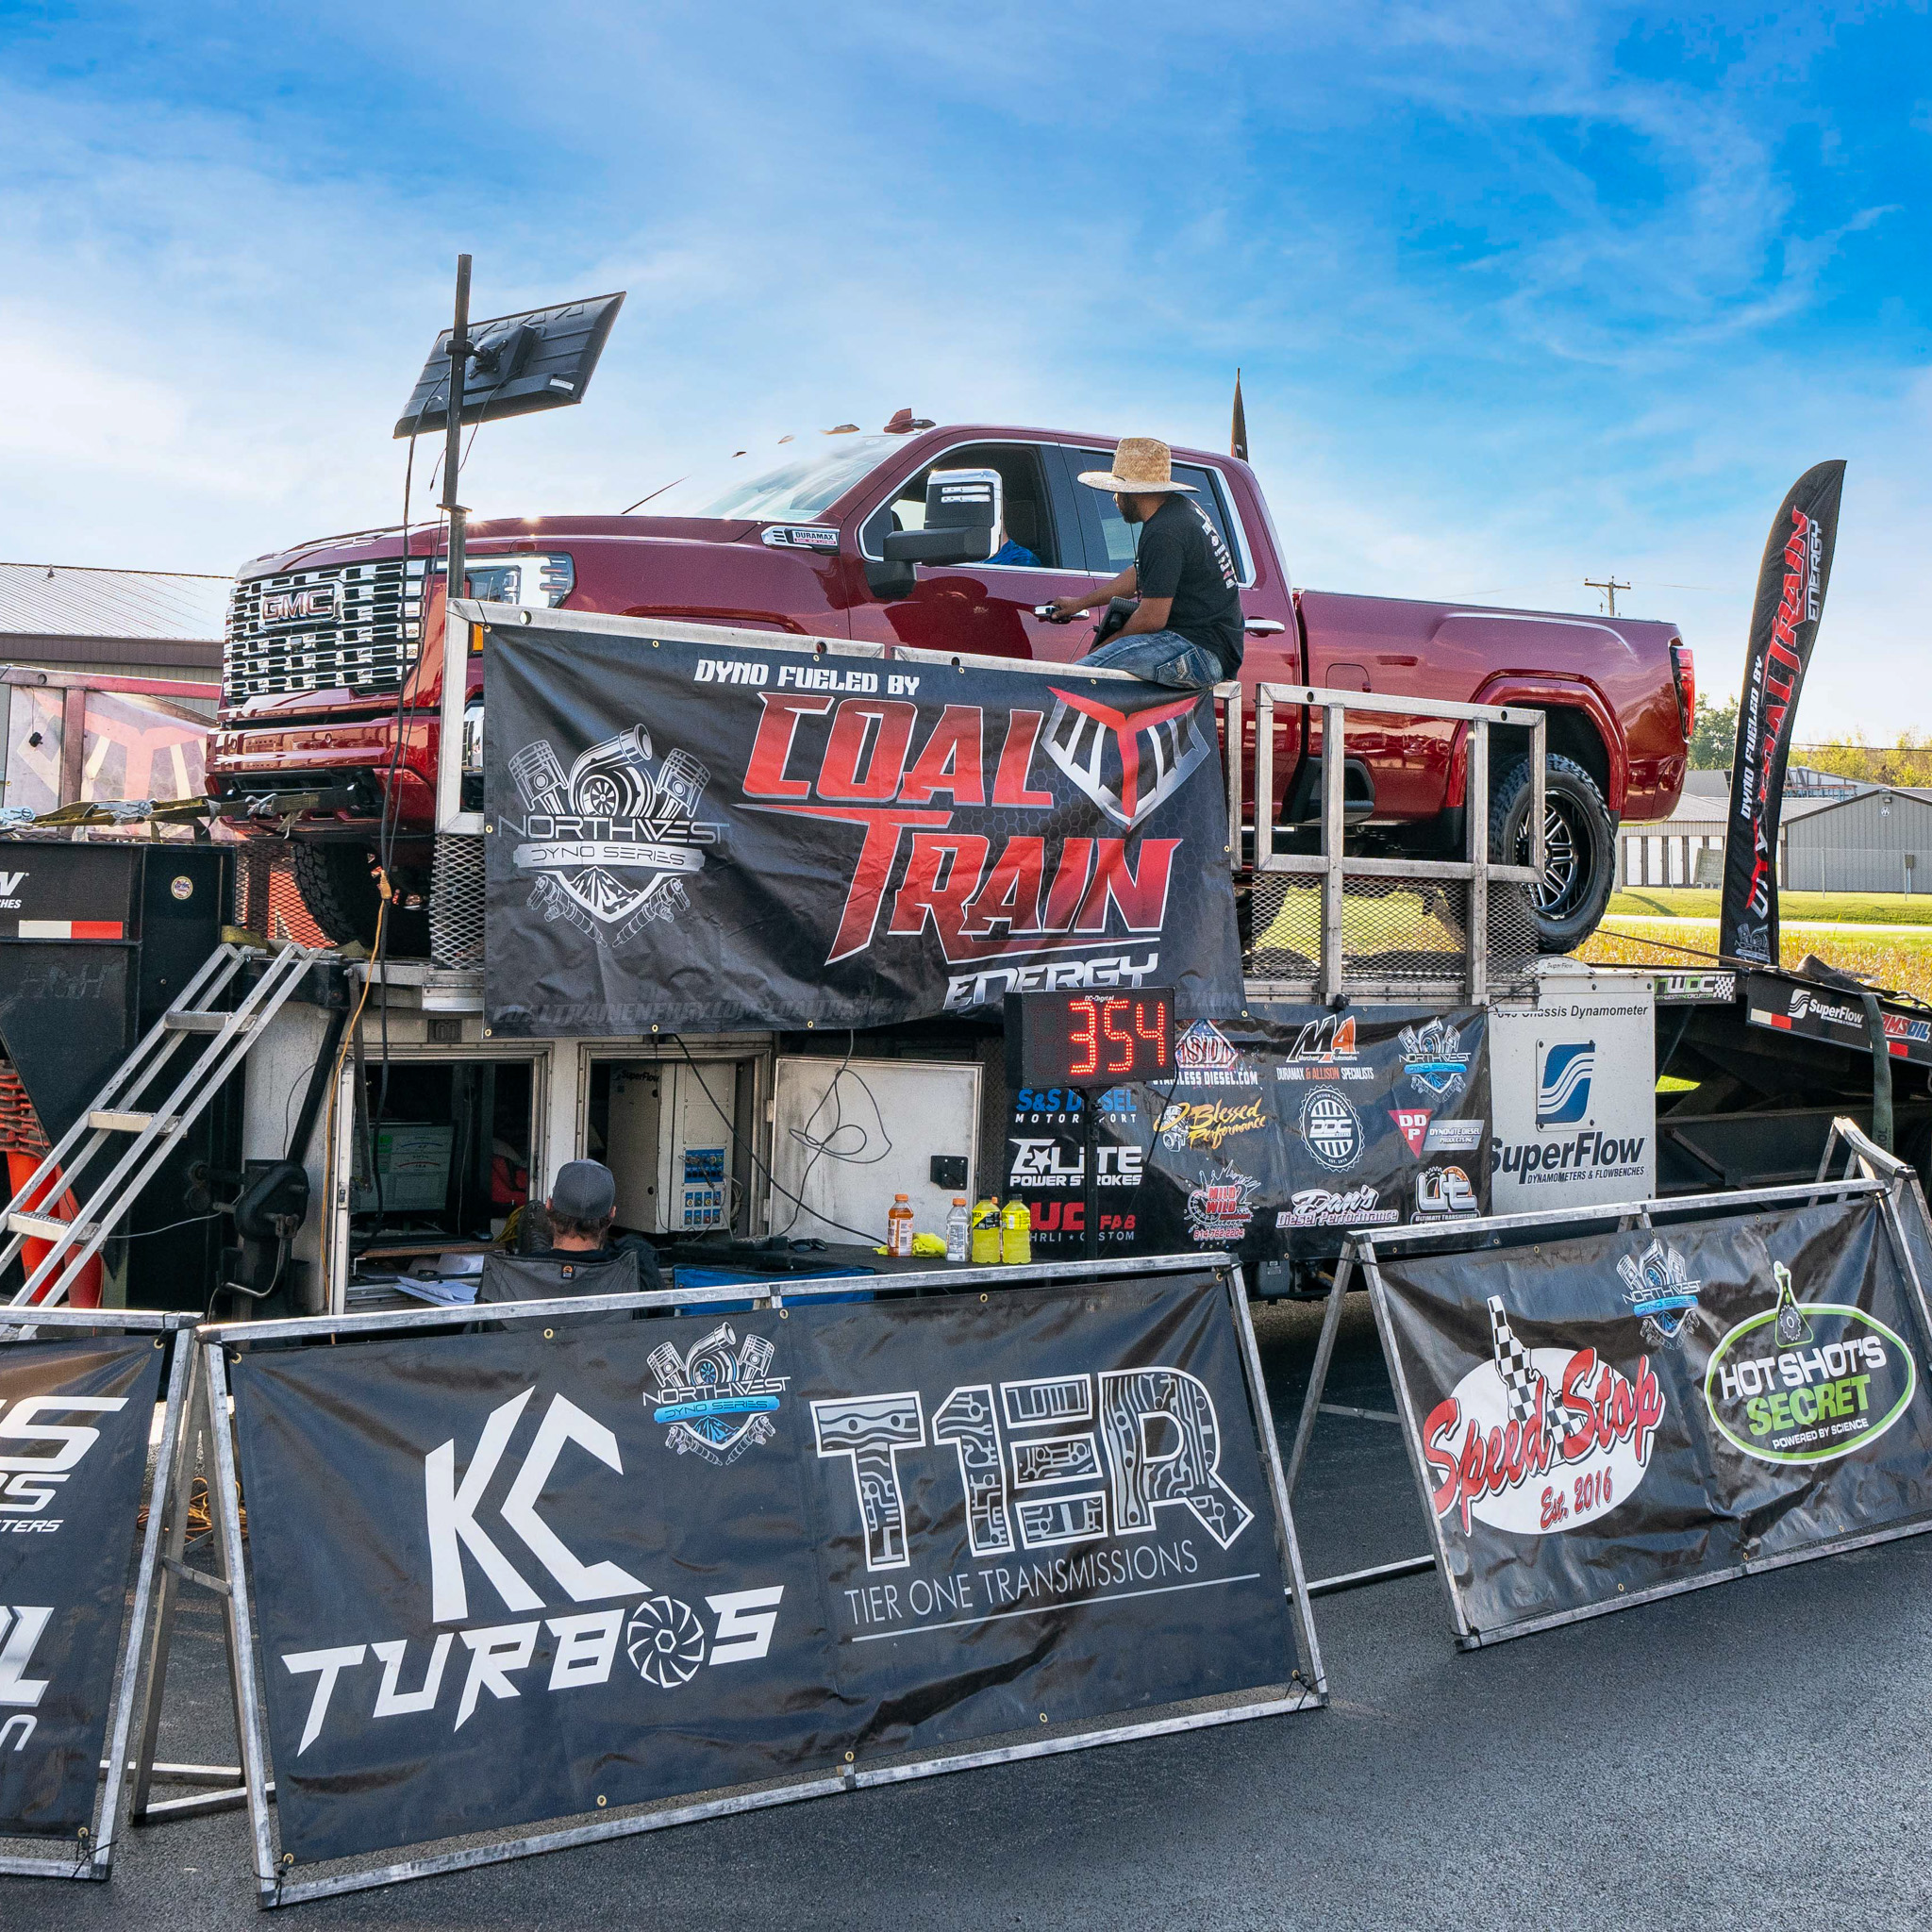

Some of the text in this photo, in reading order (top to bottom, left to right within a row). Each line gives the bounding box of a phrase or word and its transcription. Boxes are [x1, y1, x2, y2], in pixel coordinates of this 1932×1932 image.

[795, 531, 834, 541] DURAMAX
[1807, 519, 1824, 622] ENERGY
[263, 589, 334, 620] GMC
[693, 658, 920, 696] DYNO FUELED BY
[741, 691, 1053, 808] COAL
[1740, 654, 1763, 820] DYNO FUELED BY
[498, 815, 730, 844] NORTHWEST
[531, 845, 687, 866] DYNO SERIES
[733, 804, 1182, 964] TRAIN
[943, 953, 1158, 1009] ENERGY
[1085, 994, 1115, 1003] DC-Digital
[1571, 1005, 1648, 1019] Dynamometer
[1808, 998, 1865, 1024] SuperFlow
[1069, 1000, 1165, 1075] 354
[1398, 1052, 1472, 1063] NORTHWEST
[622, 1070, 660, 1082] SuperFlow
[1204, 1071, 1258, 1085] DIESEL.COM
[1276, 1067, 1305, 1080] DURAMAX
[1312, 1067, 1340, 1080] ALLISON
[1341, 1067, 1374, 1080] SPECIALISTS
[1016, 1088, 1138, 1112] S&S DSEL
[1189, 1097, 1262, 1129] Blessed
[1015, 1113, 1137, 1124] MOTORORT
[1188, 1115, 1266, 1150] Performance
[1491, 1131, 1646, 1185] SuperFlow
[1527, 1166, 1645, 1185] DYNAMOMETERS & FLOWBENCHES
[1208, 1186, 1237, 1199] MILD
[1291, 1184, 1379, 1216] Dan's
[1206, 1200, 1238, 1214] WILD
[1276, 1209, 1399, 1227] Diesel Performance
[1099, 1214, 1136, 1230] FAB
[1029, 1231, 1135, 1241] HRLI CSTOM
[1622, 1280, 1701, 1305] NORTHWEST
[1639, 1302, 1663, 1313] DYNO
[642, 1376, 791, 1407] NORTHWEST
[1746, 1374, 1871, 1436] SECRET
[664, 1400, 768, 1419] DYNO SERIES
[0, 1395, 130, 1473] S
[1423, 1346, 1666, 1537] Speed Stop
[1772, 1418, 1870, 1450] POWERED BY SCIENCE
[1574, 1465, 1612, 1514] 2016
[425, 1385, 653, 1624] KC
[0, 1519, 64, 1533] TERS
[844, 1540, 1199, 1624] TIER ONE TRANSMISSIONS
